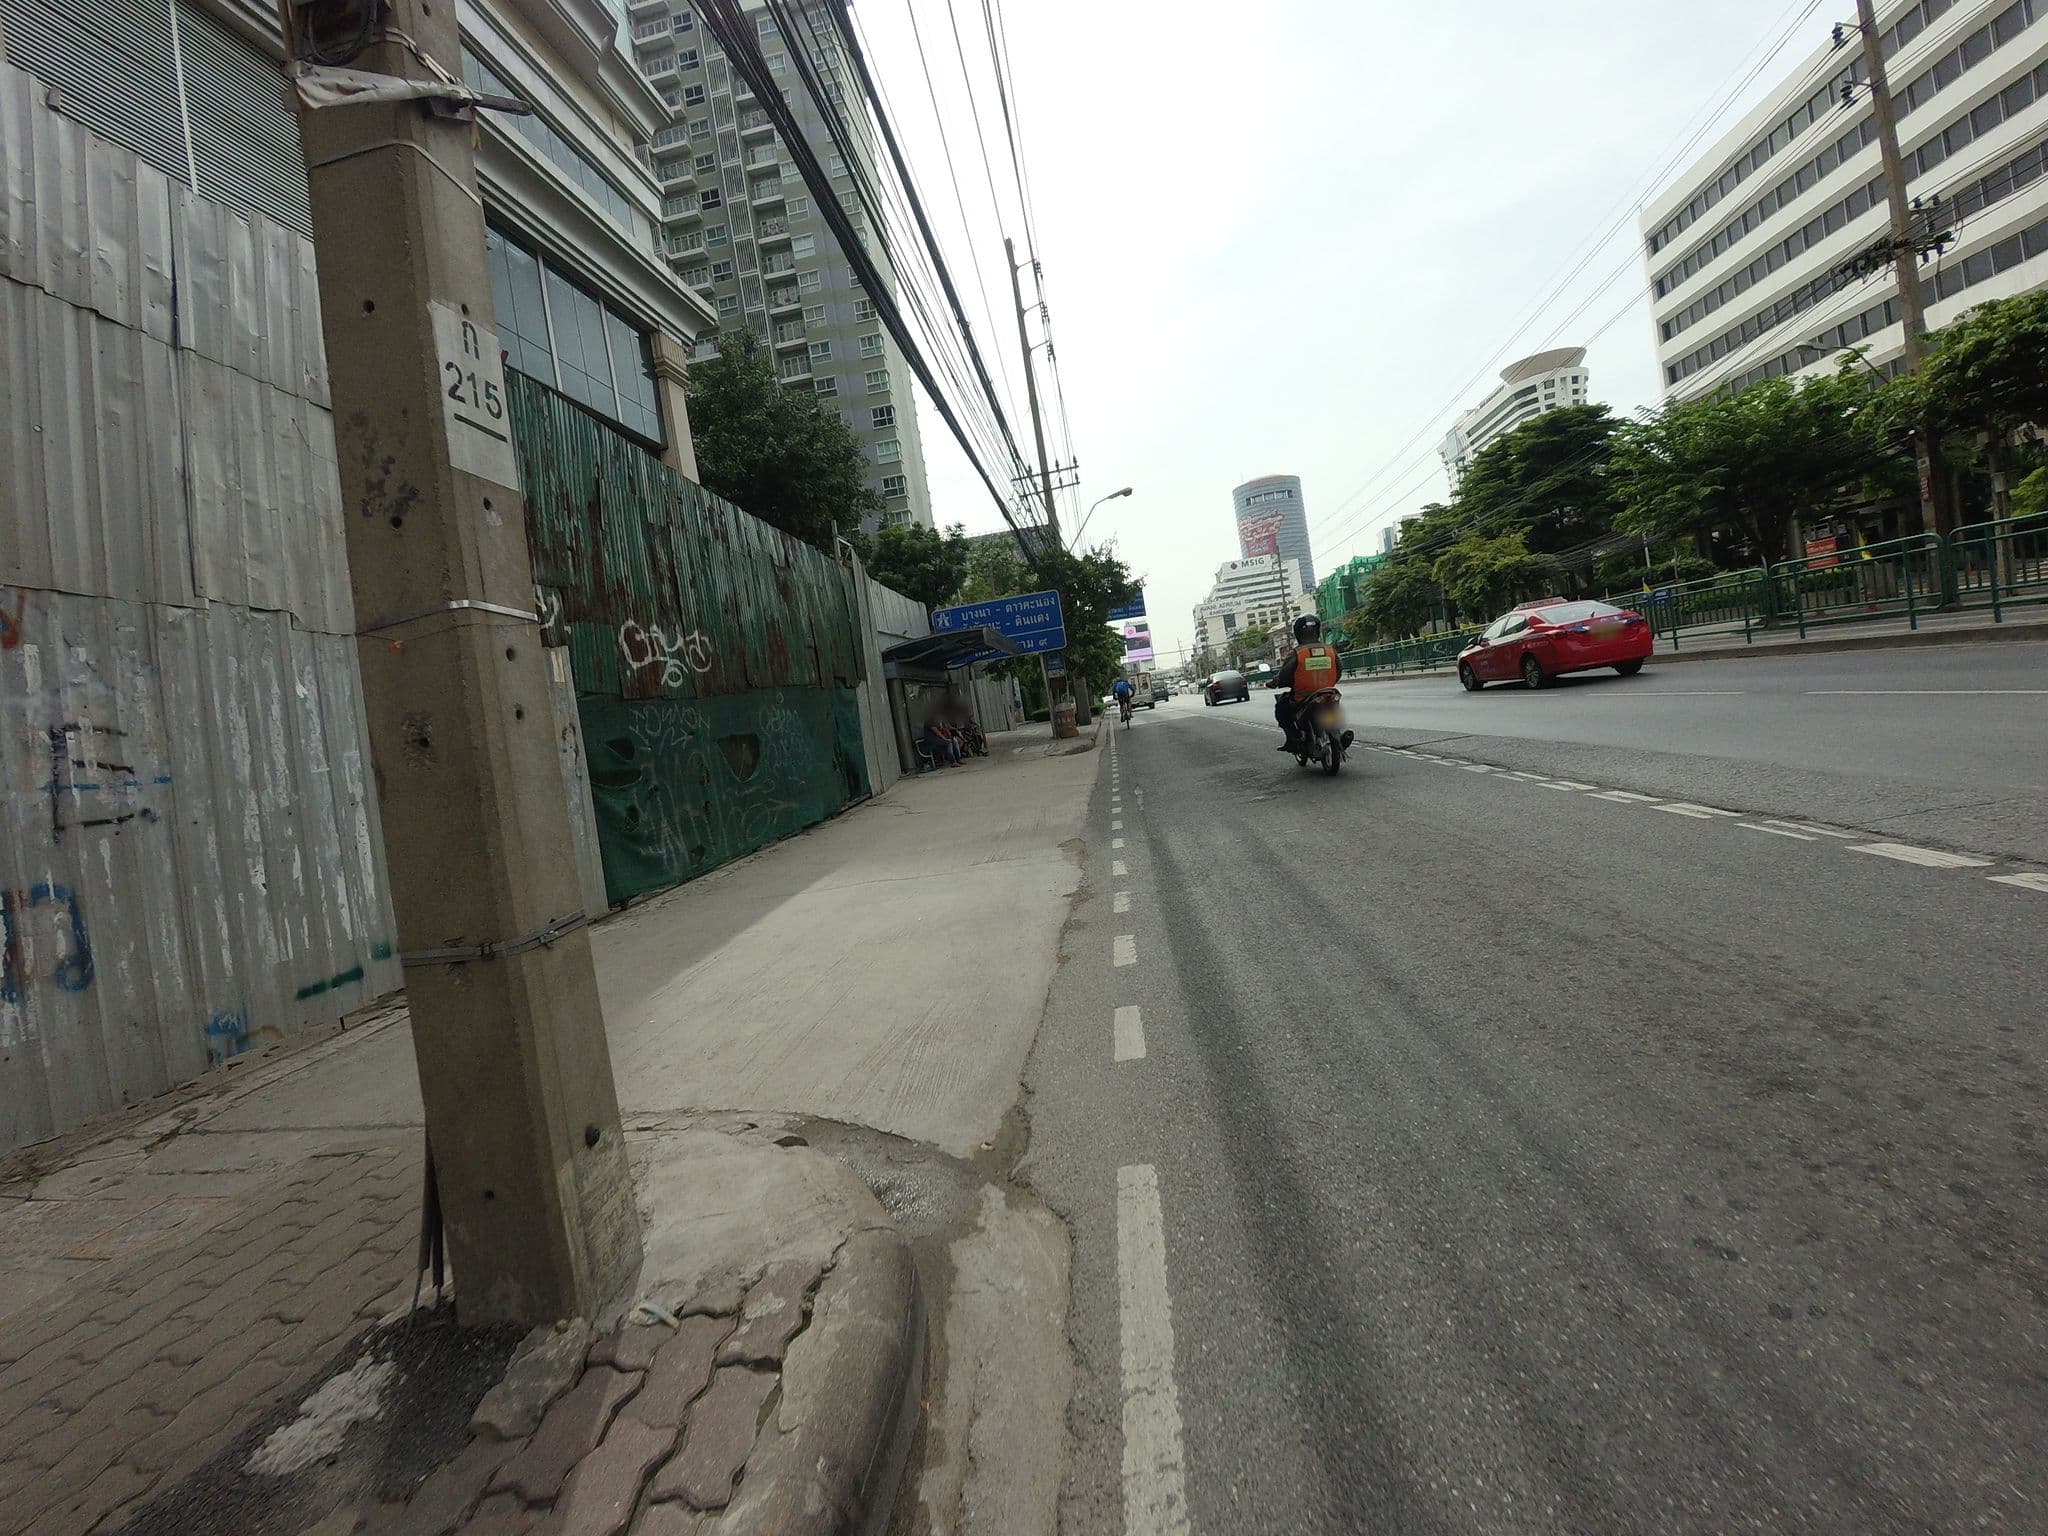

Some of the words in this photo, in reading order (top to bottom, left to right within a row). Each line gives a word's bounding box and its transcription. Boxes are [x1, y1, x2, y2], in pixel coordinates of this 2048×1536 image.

[445, 361, 503, 420] 215
[1241, 557, 1265, 568] MSIG
[1005, 596, 1055, 613] ดาวคะนอง
[1015, 613, 1050, 626] ดินแดง
